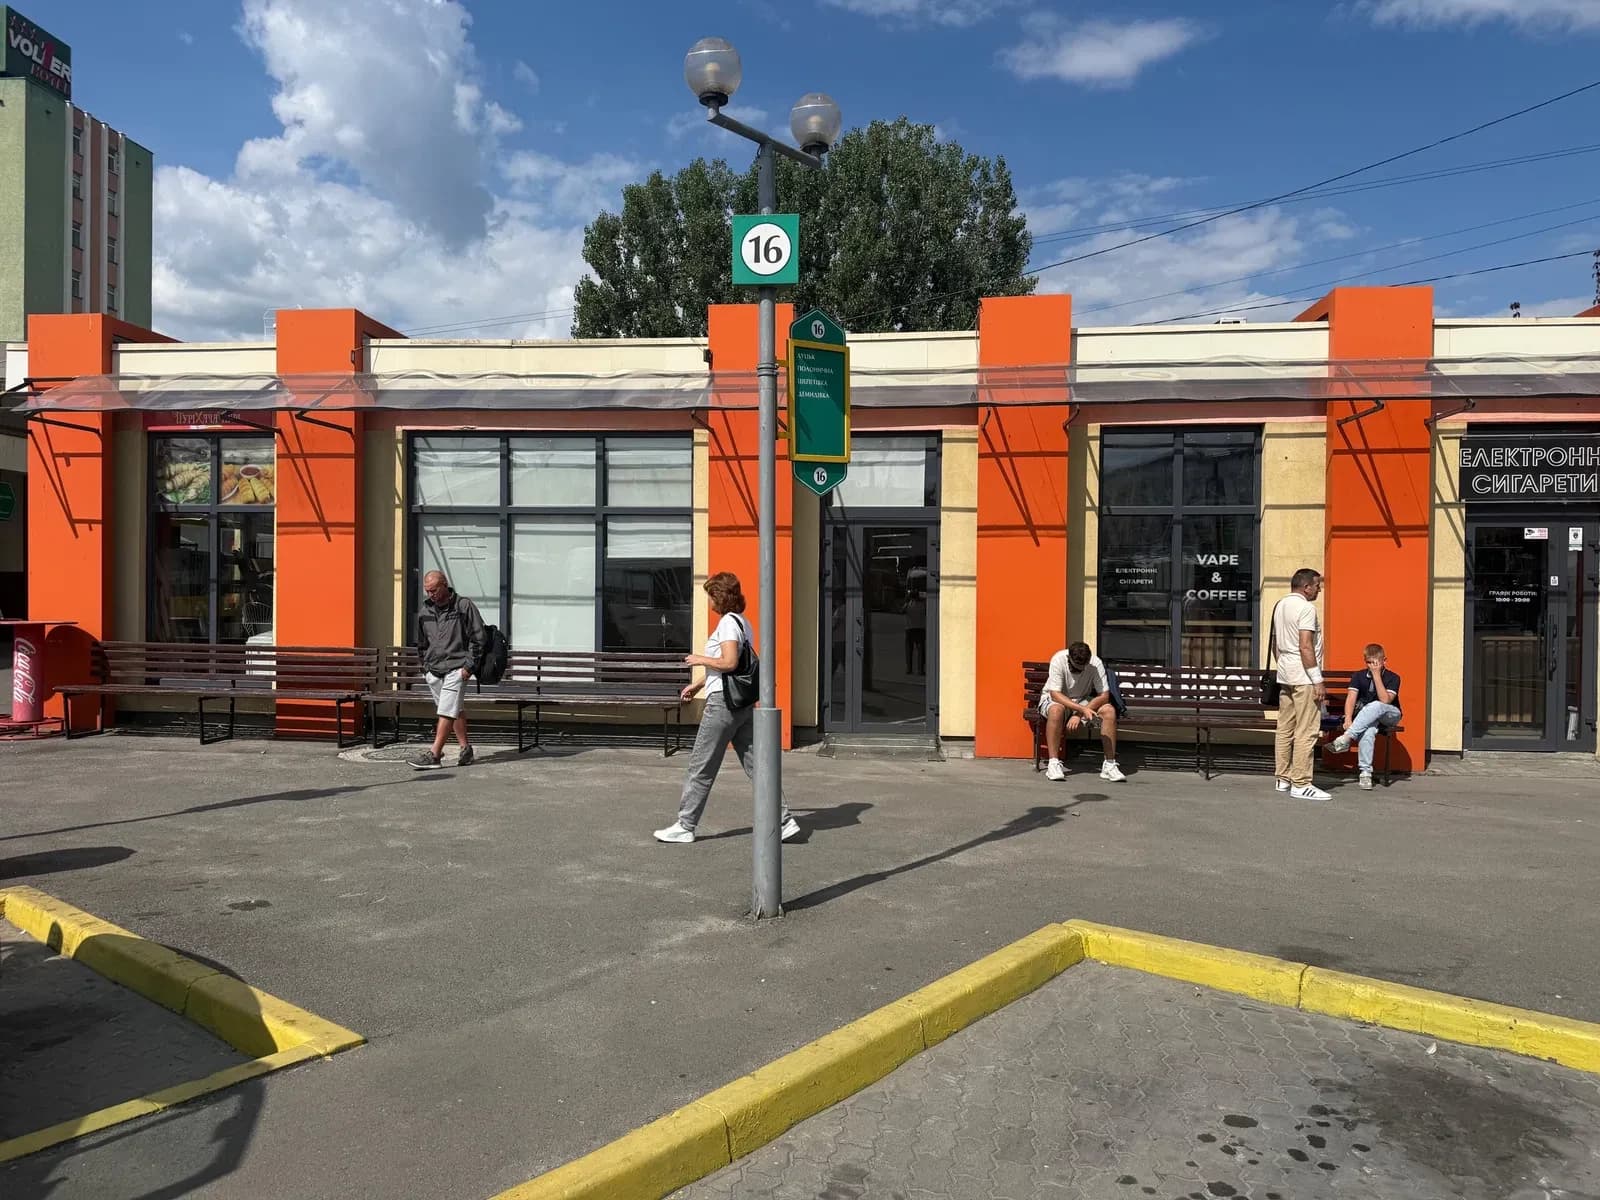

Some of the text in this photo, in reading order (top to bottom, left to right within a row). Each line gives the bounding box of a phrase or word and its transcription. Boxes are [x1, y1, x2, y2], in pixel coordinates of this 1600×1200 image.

[748, 235, 783, 264] 16
[813, 324, 824, 335] 16
[798, 391, 830, 399] ДЕМИДІВКА
[815, 470, 826, 483] 16
[1472, 474, 1598, 494] СИГАРЕТИ
[1196, 554, 1239, 566] VAPE
[1211, 571, 1222, 583] &
[1186, 589, 1247, 601] COFFEE
